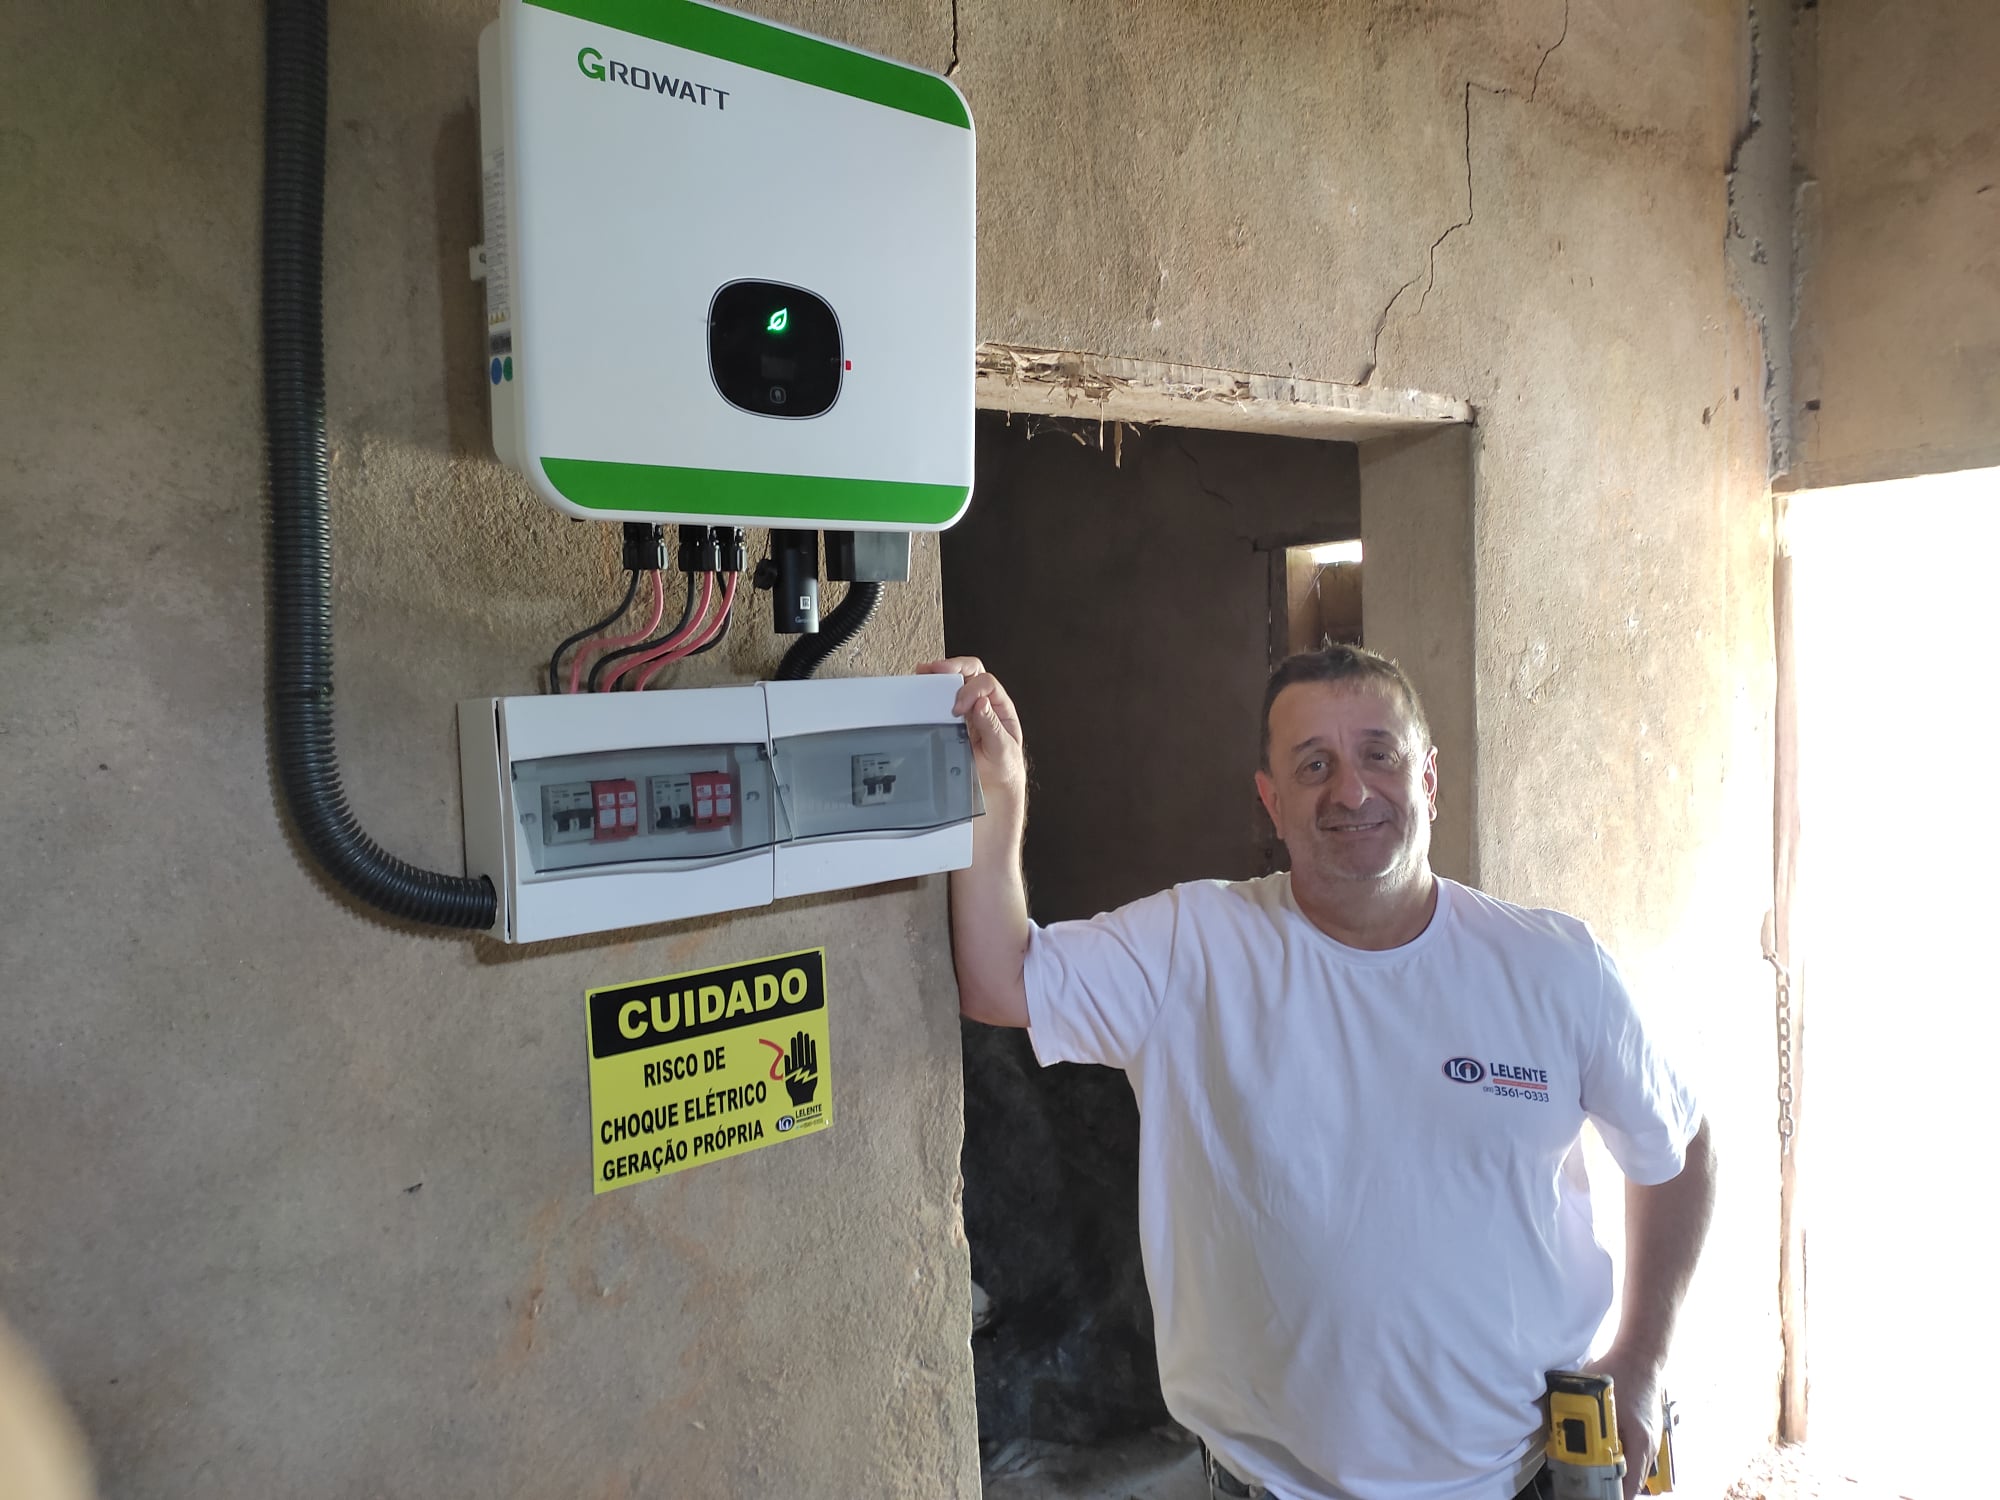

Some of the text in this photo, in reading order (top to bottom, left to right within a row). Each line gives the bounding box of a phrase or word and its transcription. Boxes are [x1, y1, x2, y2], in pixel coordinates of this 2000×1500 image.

[577, 47, 730, 111] GROWATT
[617, 967, 808, 1040] CUIDADO
[643, 1046, 726, 1088] RISCO DE
[1489, 1062, 1548, 1083] LELENTE
[600, 1080, 767, 1144] CHOQUE ELÉTRICO
[795, 1103, 822, 1119] LELENTE
[602, 1119, 764, 1181] GERAÇÃO PRÓPRIA
